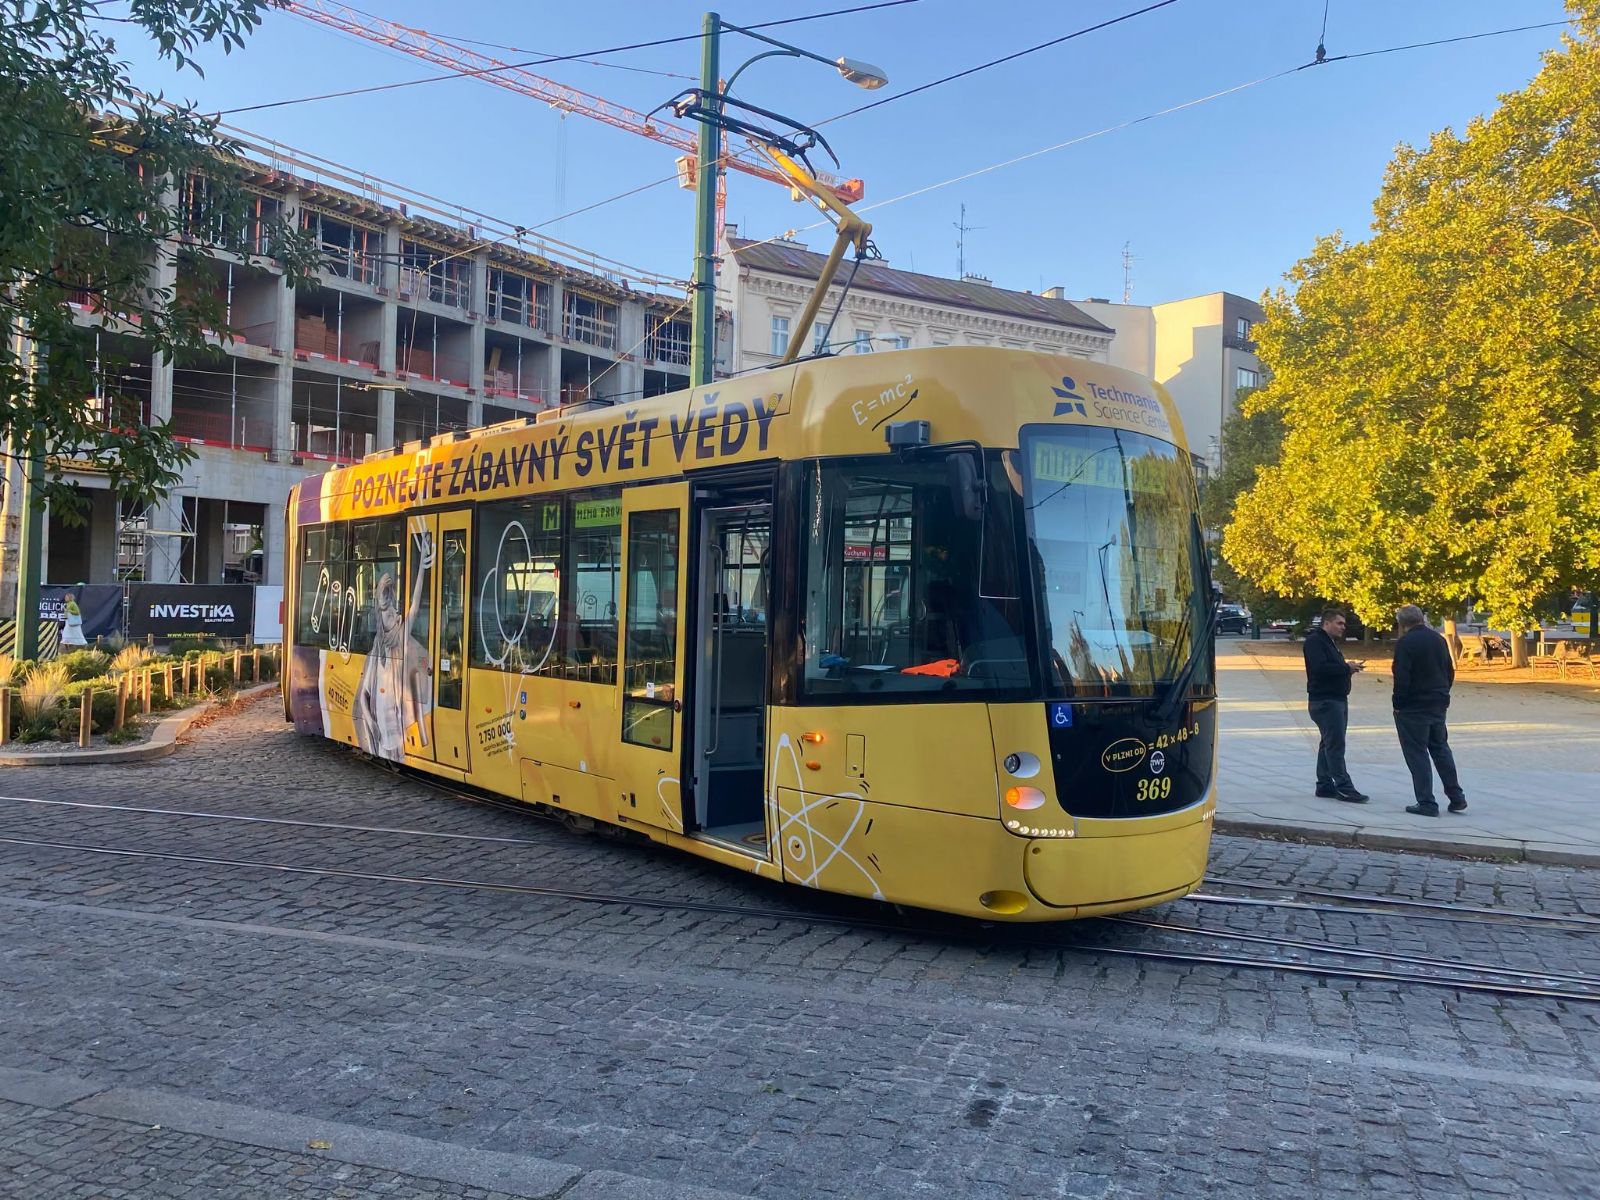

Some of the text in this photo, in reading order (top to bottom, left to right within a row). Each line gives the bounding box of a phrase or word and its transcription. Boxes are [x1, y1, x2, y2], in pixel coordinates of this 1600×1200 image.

[1087, 382, 1161, 413] Techmania
[1093, 401, 1140, 424] Science
[351, 391, 783, 511] POZNEJTE ZÁBAVNÝ SVĚT VĚDY
[545, 506, 558, 530] M
[600, 505, 622, 519] PROV
[1112, 749, 1133, 761] PLZNI
[1134, 747, 1145, 756] OD
[1156, 734, 1169, 749] 42
[1177, 727, 1188, 742] 48
[1136, 776, 1172, 801] 369
